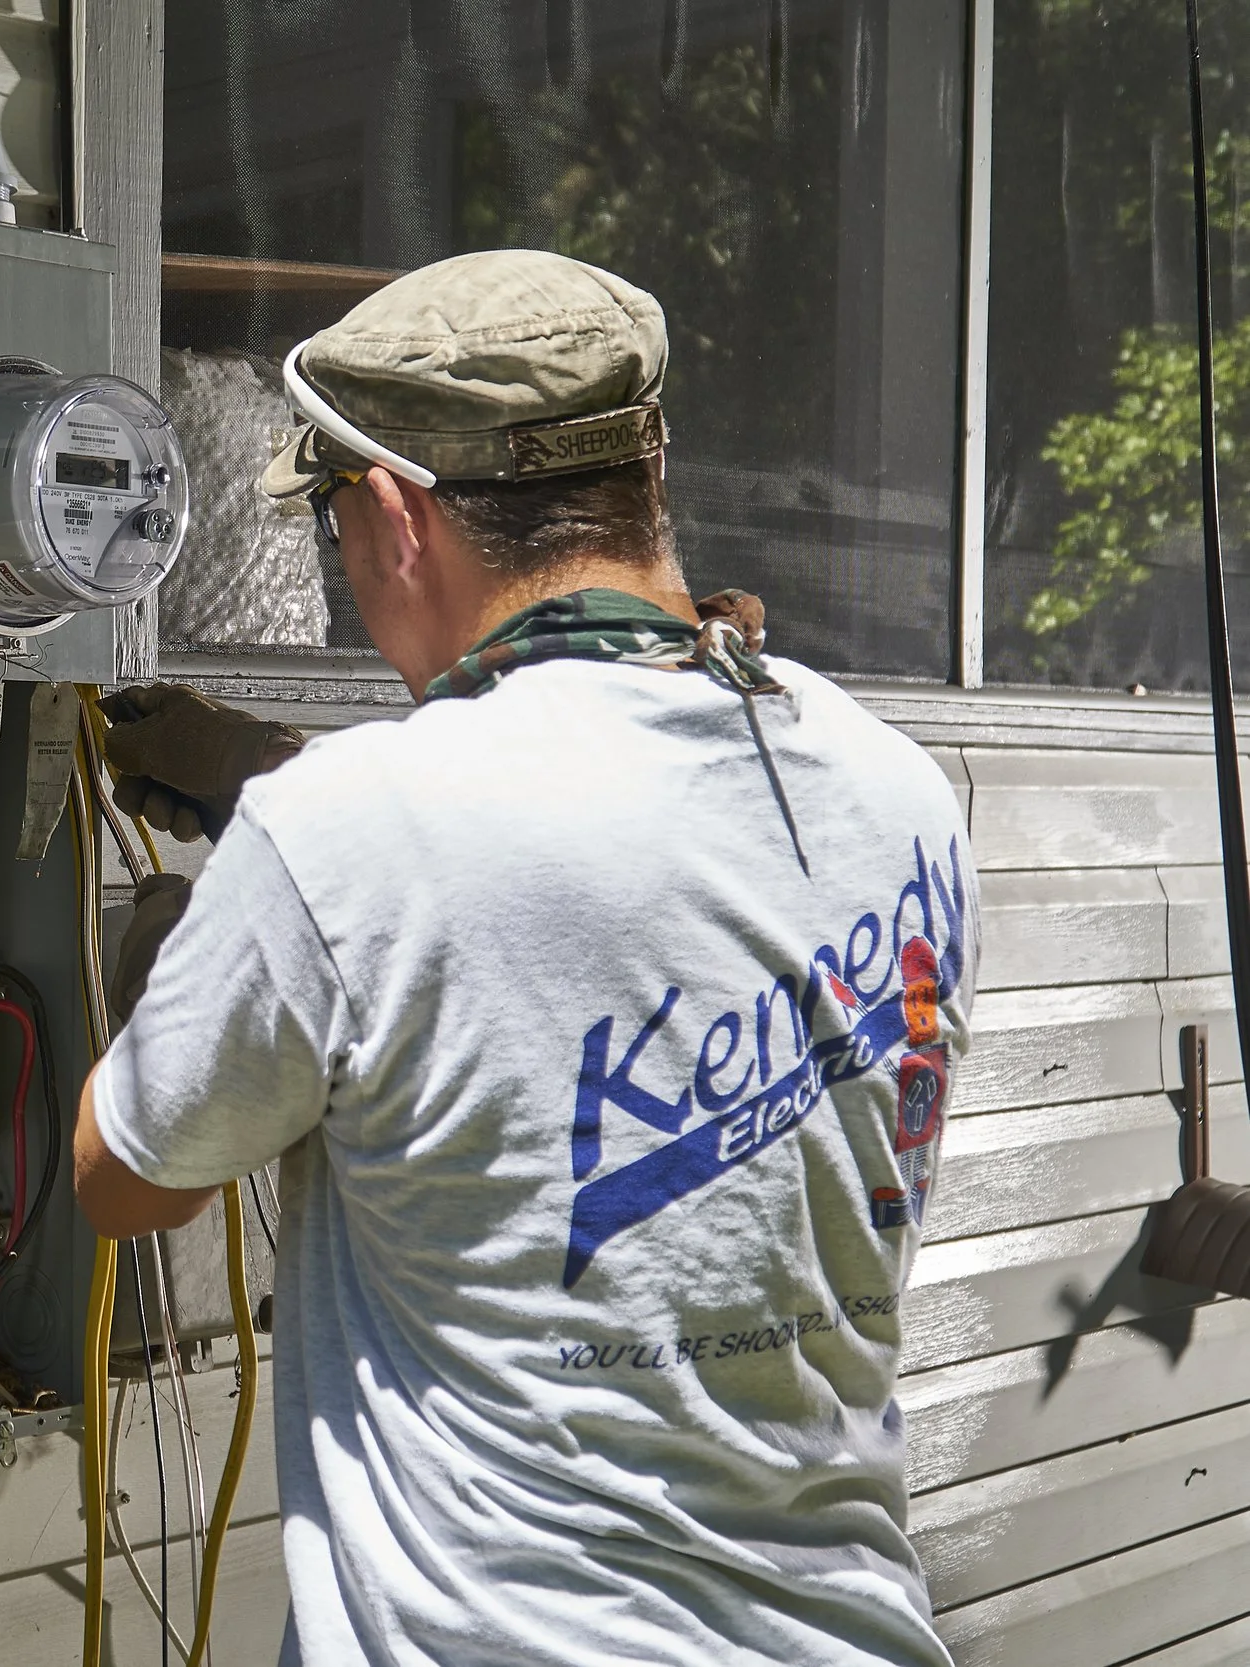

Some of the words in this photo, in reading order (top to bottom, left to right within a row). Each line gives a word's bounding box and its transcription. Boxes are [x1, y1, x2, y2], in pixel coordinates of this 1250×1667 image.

[556, 422, 640, 459] SHEEPDOG
[76, 519, 91, 528] ENERGY
[571, 833, 965, 1182] Kennedy
[718, 1034, 874, 1162] Electric
[560, 1344, 668, 1370] YOU'LL
[676, 1336, 712, 1364] BE
